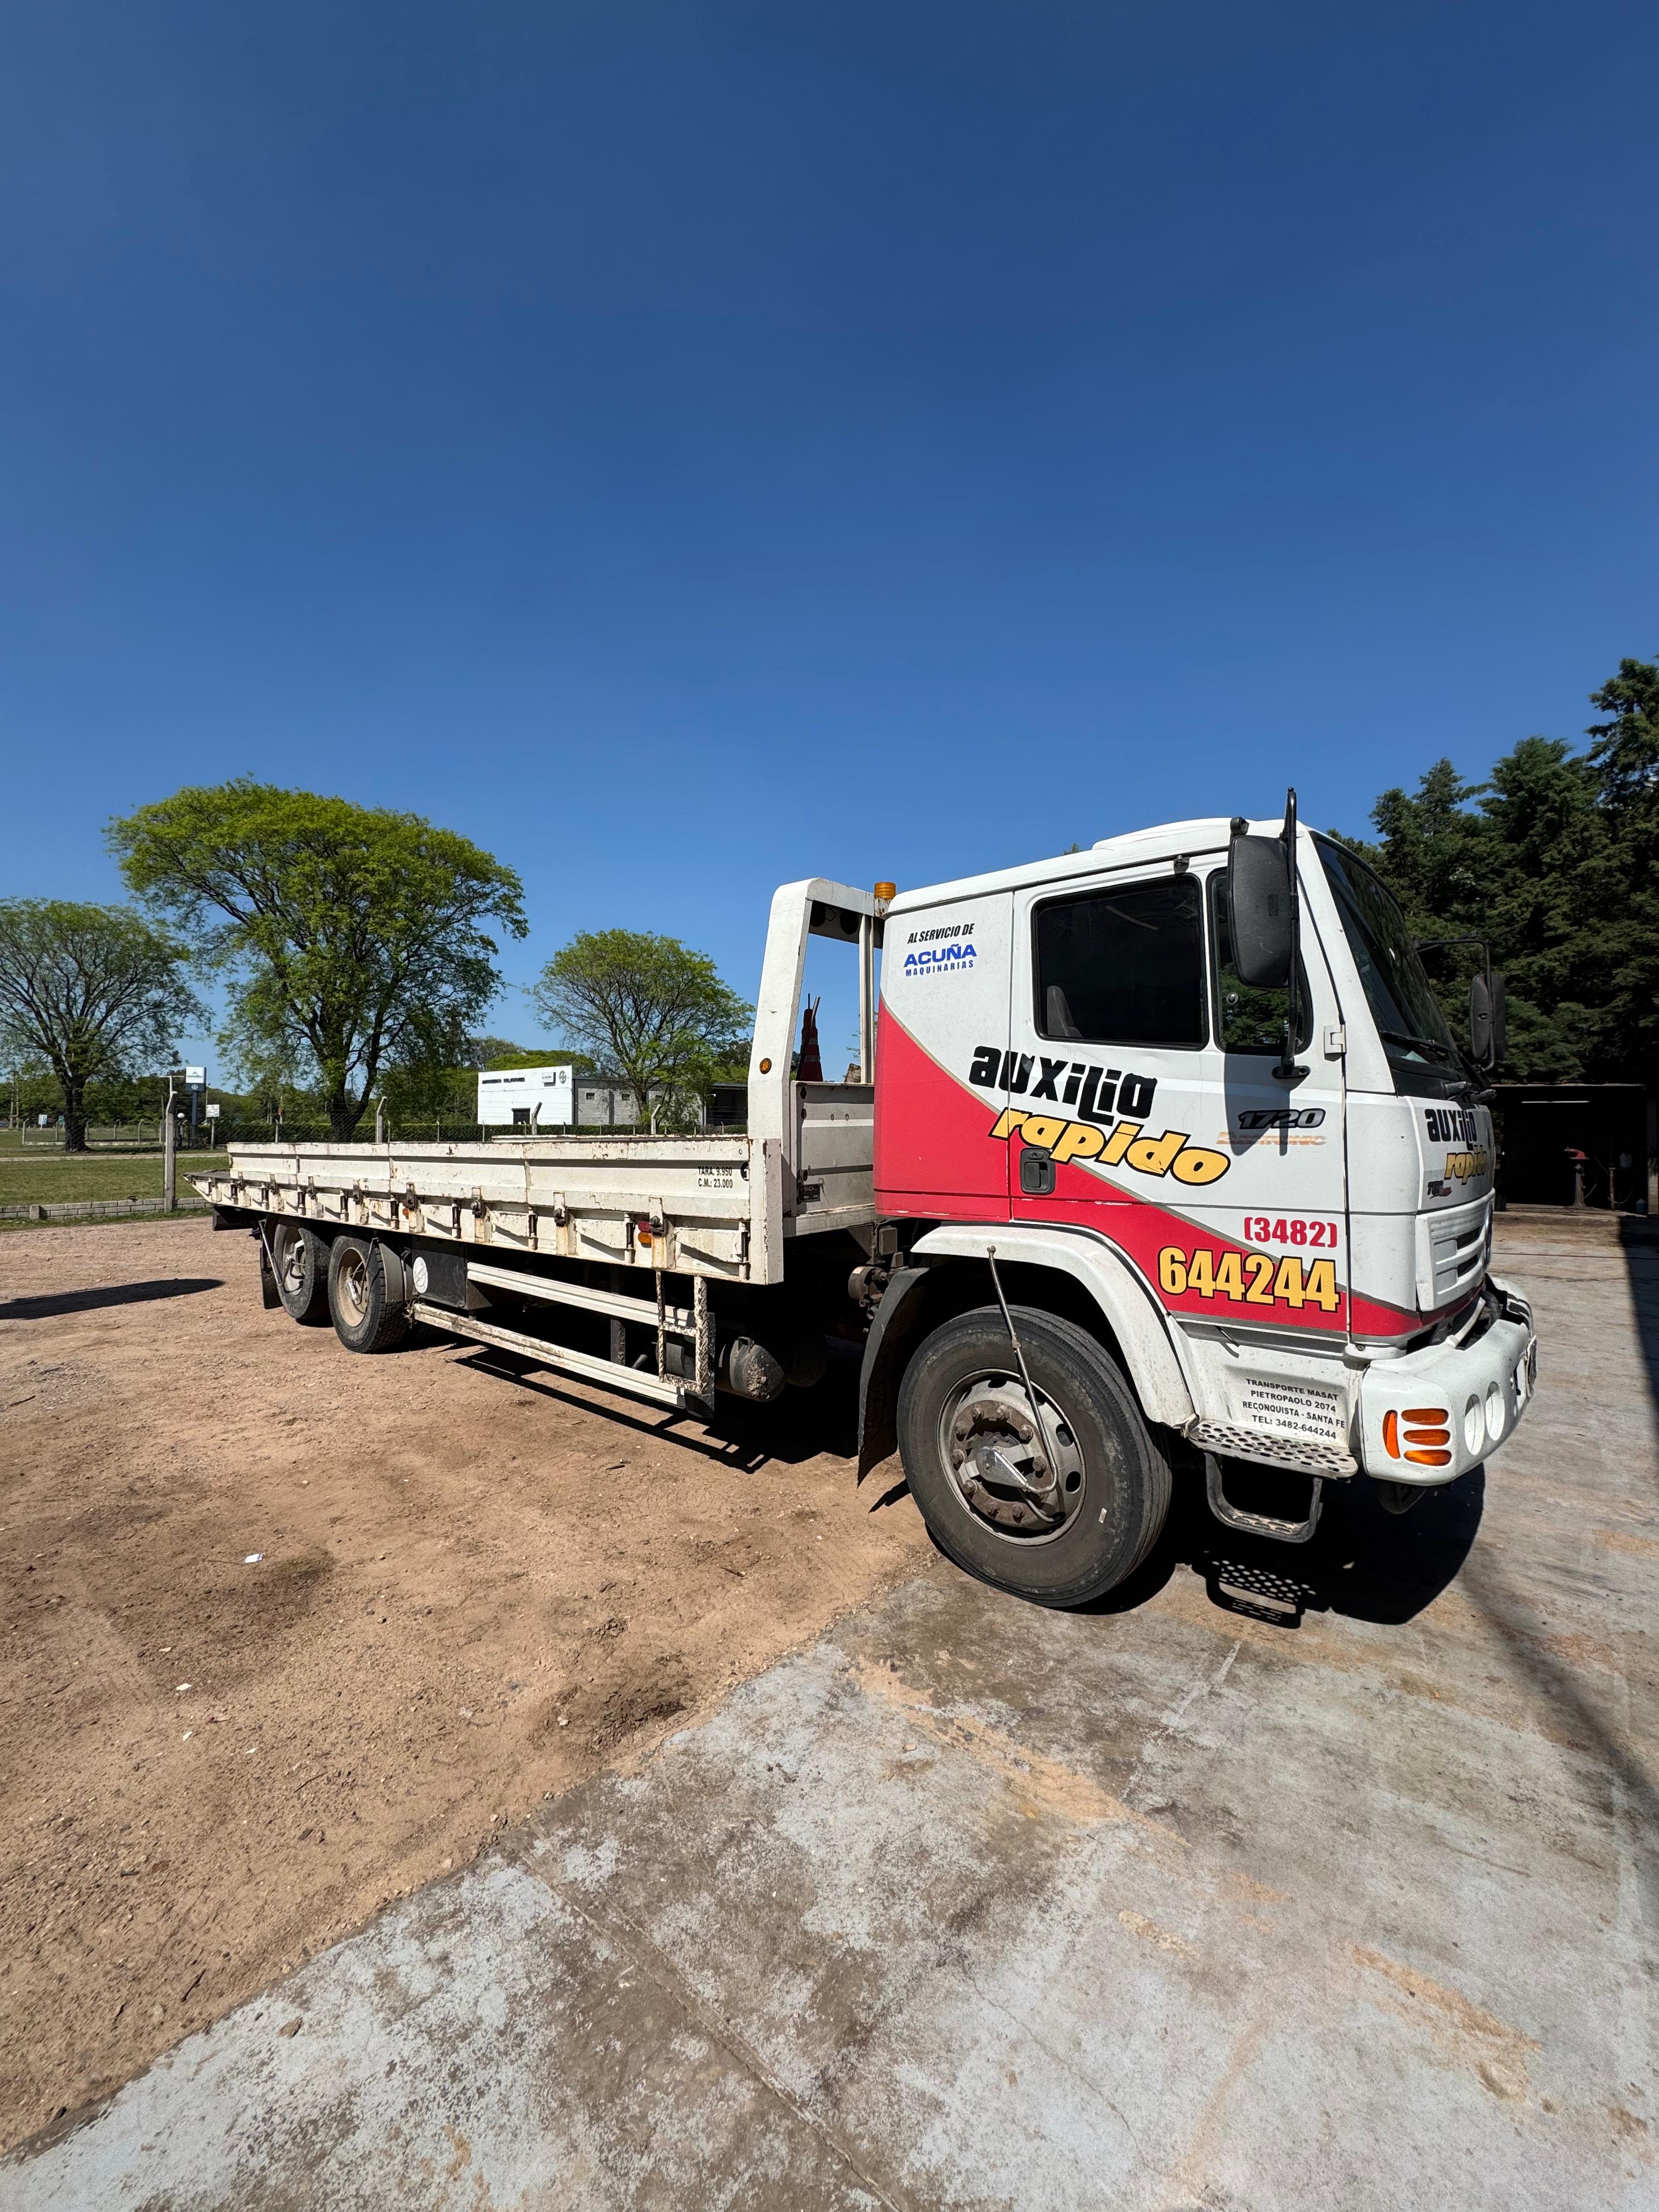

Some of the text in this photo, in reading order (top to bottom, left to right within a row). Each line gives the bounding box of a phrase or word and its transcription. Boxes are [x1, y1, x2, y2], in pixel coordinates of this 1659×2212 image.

[907, 923, 975, 944] AL SERVICIO DE
[903, 944, 977, 967] ACUÑA
[906, 960, 973, 977] MAQUINARIAS
[1238, 1108, 1326, 1129] 1720
[988, 1107, 1231, 1186] rapido
[714, 1178, 733, 1188] 23.000
[1244, 1217, 1337, 1248] (3482)
[1157, 1245, 1342, 1313] 644244
[1246, 1379, 1338, 1401] TRANSPORTE MASAT
[1251, 1390, 1336, 1412] PIETROPAOLO 2074
[1243, 1401, 1300, 1417] RECONQUISTA
[1307, 1412, 1333, 1425] SANTA
[1336, 1419, 1345, 1429] FE
[1276, 1419, 1336, 1439] 3482-644244
